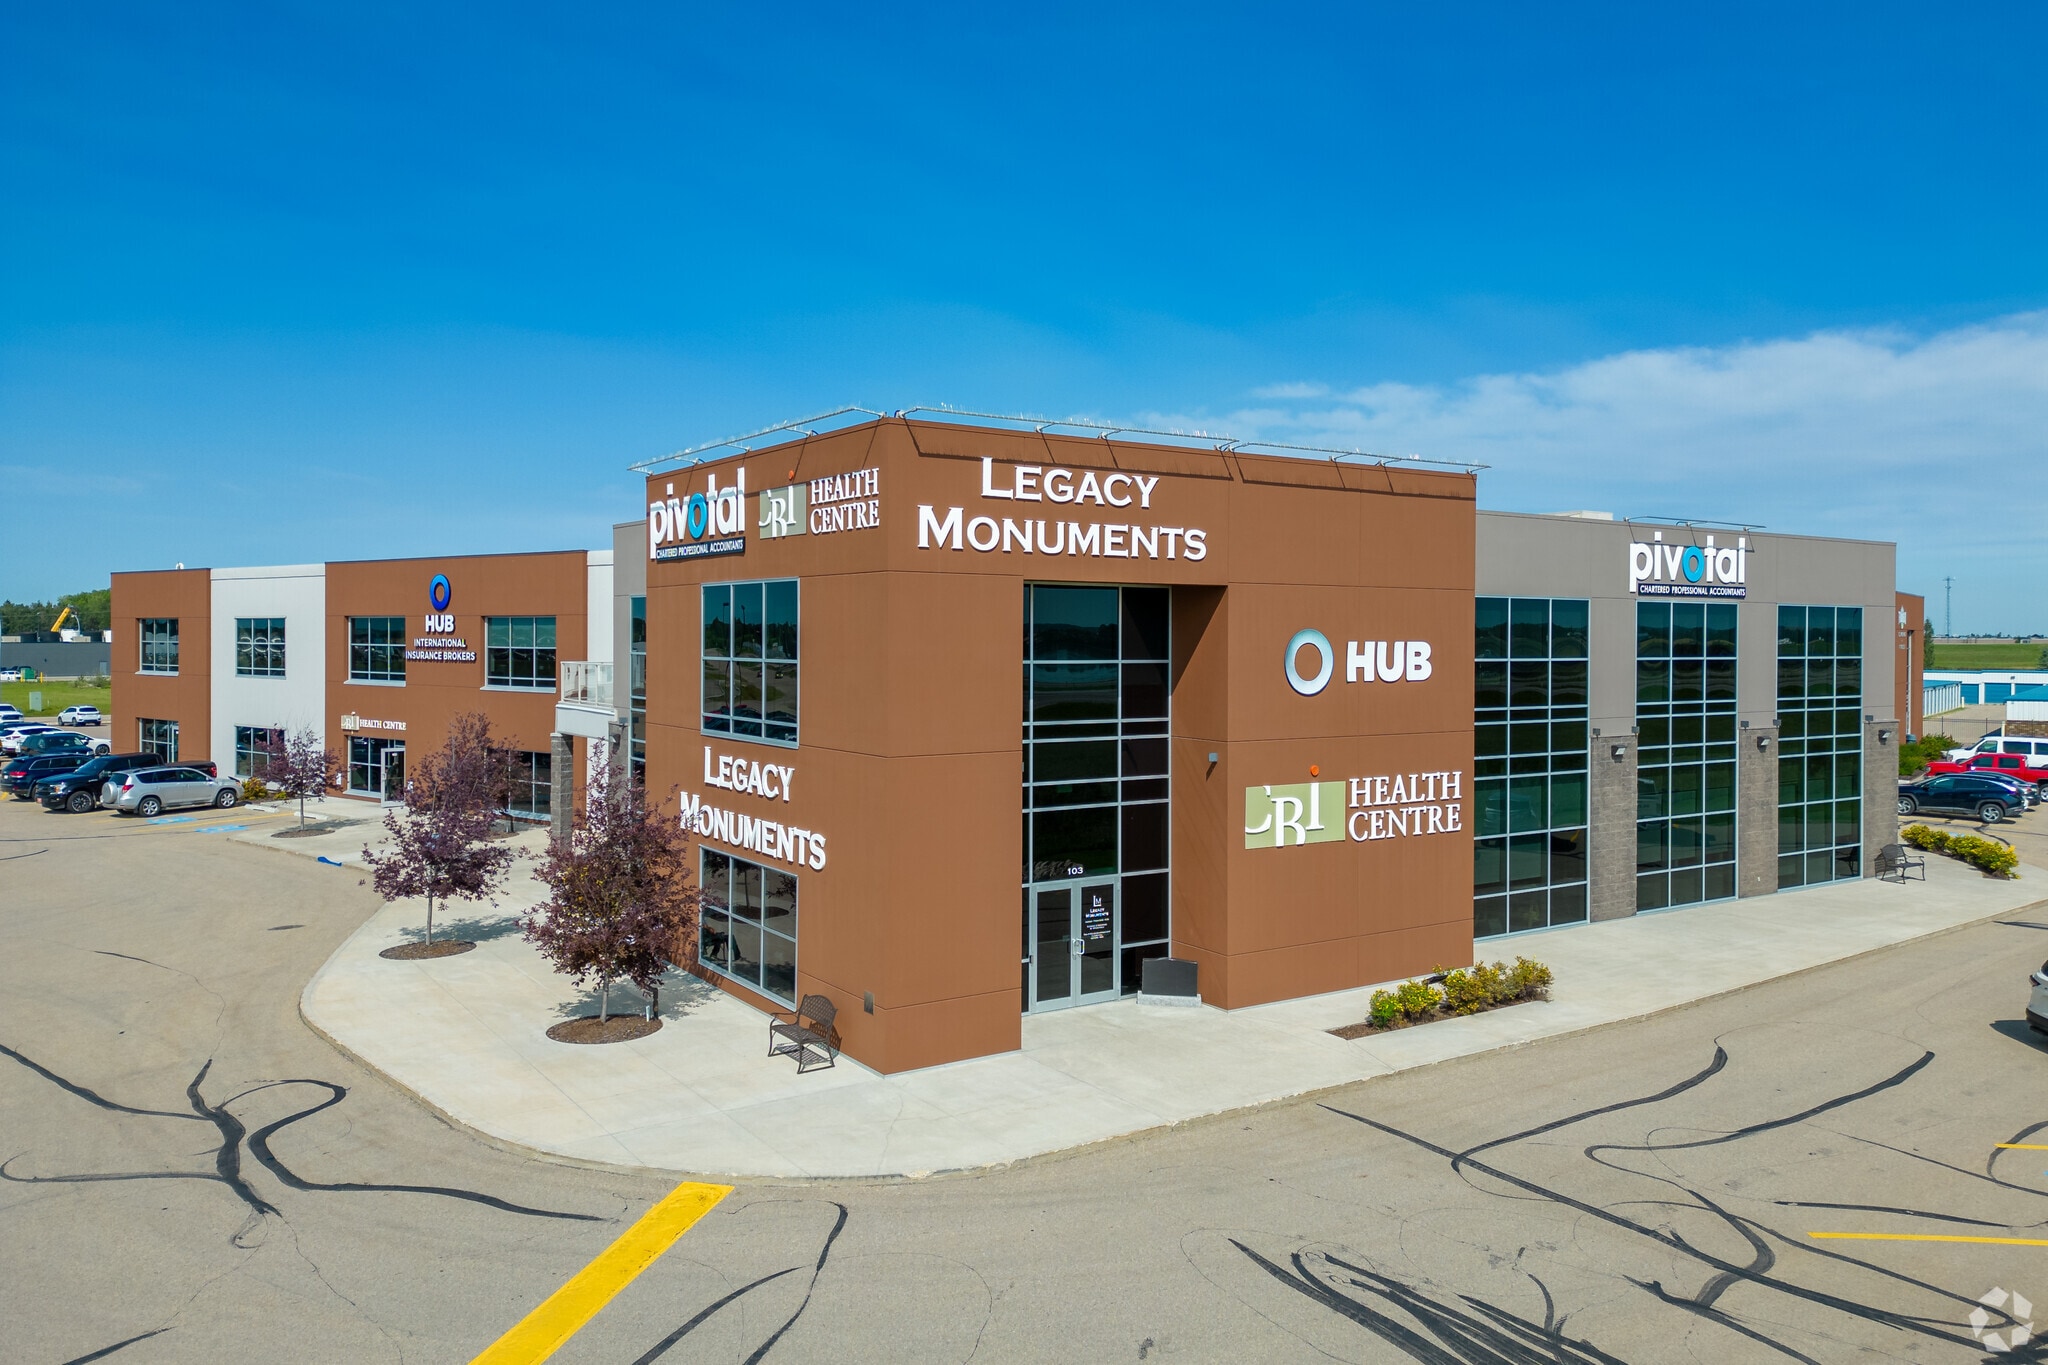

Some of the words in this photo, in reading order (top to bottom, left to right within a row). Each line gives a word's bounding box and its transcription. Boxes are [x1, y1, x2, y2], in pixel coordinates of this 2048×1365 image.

[810, 467, 880, 505] HEALTH
[980, 456, 1160, 509] LEGACY
[650, 467, 746, 560] pivotal
[810, 500, 880, 535] CENTRE
[656, 547, 678, 559] CHARTERED
[678, 542, 709, 556] PROFESSIONAL
[709, 539, 744, 553] ACCOUNTANTS
[917, 504, 1208, 561] MONUMENTS
[1629, 531, 1746, 593] pivotal
[1640, 584, 1670, 594] CHARTERED
[1671, 586, 1708, 596] PROFESSIONAL
[1709, 587, 1746, 597] ACCOUNTANTS
[425, 614, 455, 633] HUB
[405, 650, 442, 660] INSURANCE
[443, 651, 476, 661] BROKERS
[414, 638, 466, 648] INTERNATIONAL
[1346, 641, 1433, 683] HUB
[360, 719, 382, 729] HEALTH
[382, 720, 407, 731] CENTRE
[704, 746, 795, 802] LEGACY
[1349, 771, 1462, 808] HEALTH
[680, 791, 827, 871] MONUMENTS
[1348, 803, 1462, 842] CENTRE
[1067, 866, 1084, 875] 103
